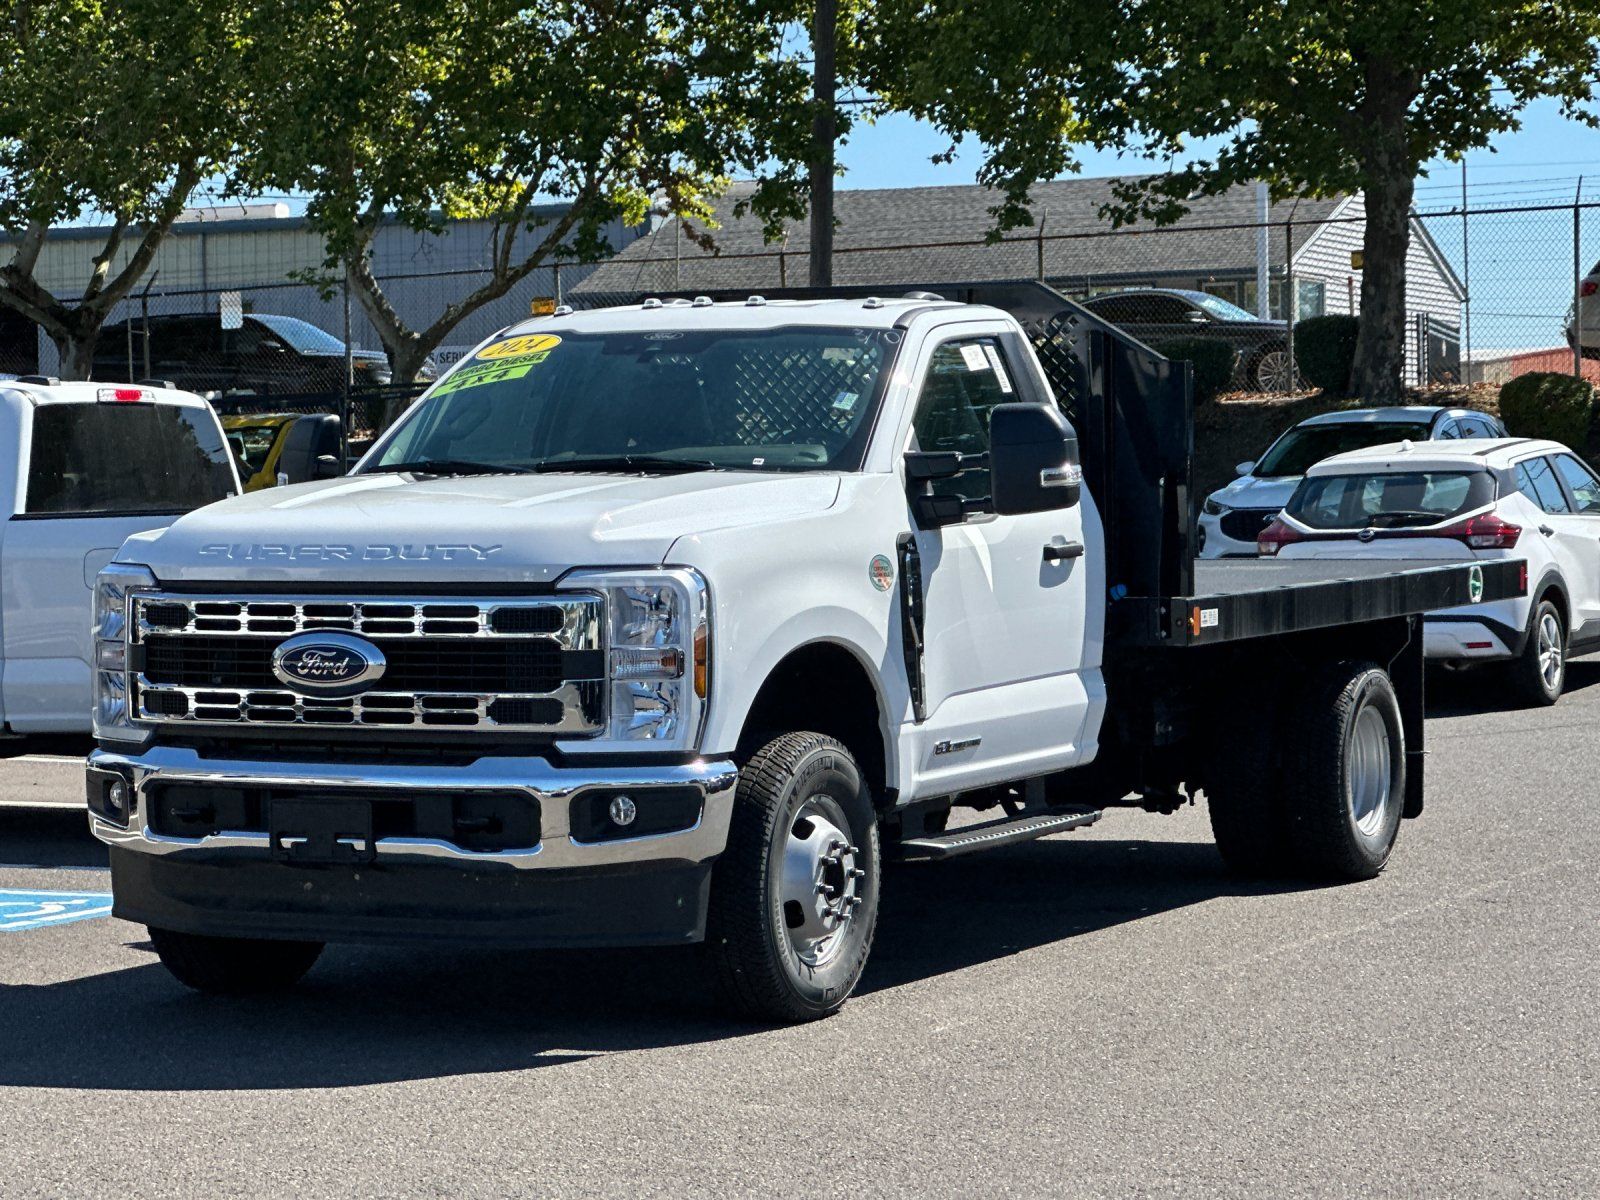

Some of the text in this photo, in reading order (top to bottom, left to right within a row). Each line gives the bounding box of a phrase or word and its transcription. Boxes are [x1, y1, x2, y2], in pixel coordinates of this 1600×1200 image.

[483, 336, 552, 357] 2024
[496, 351, 545, 369] DIESEL
[199, 543, 503, 561] SUPER DUTY
[296, 649, 350, 676] Ford
